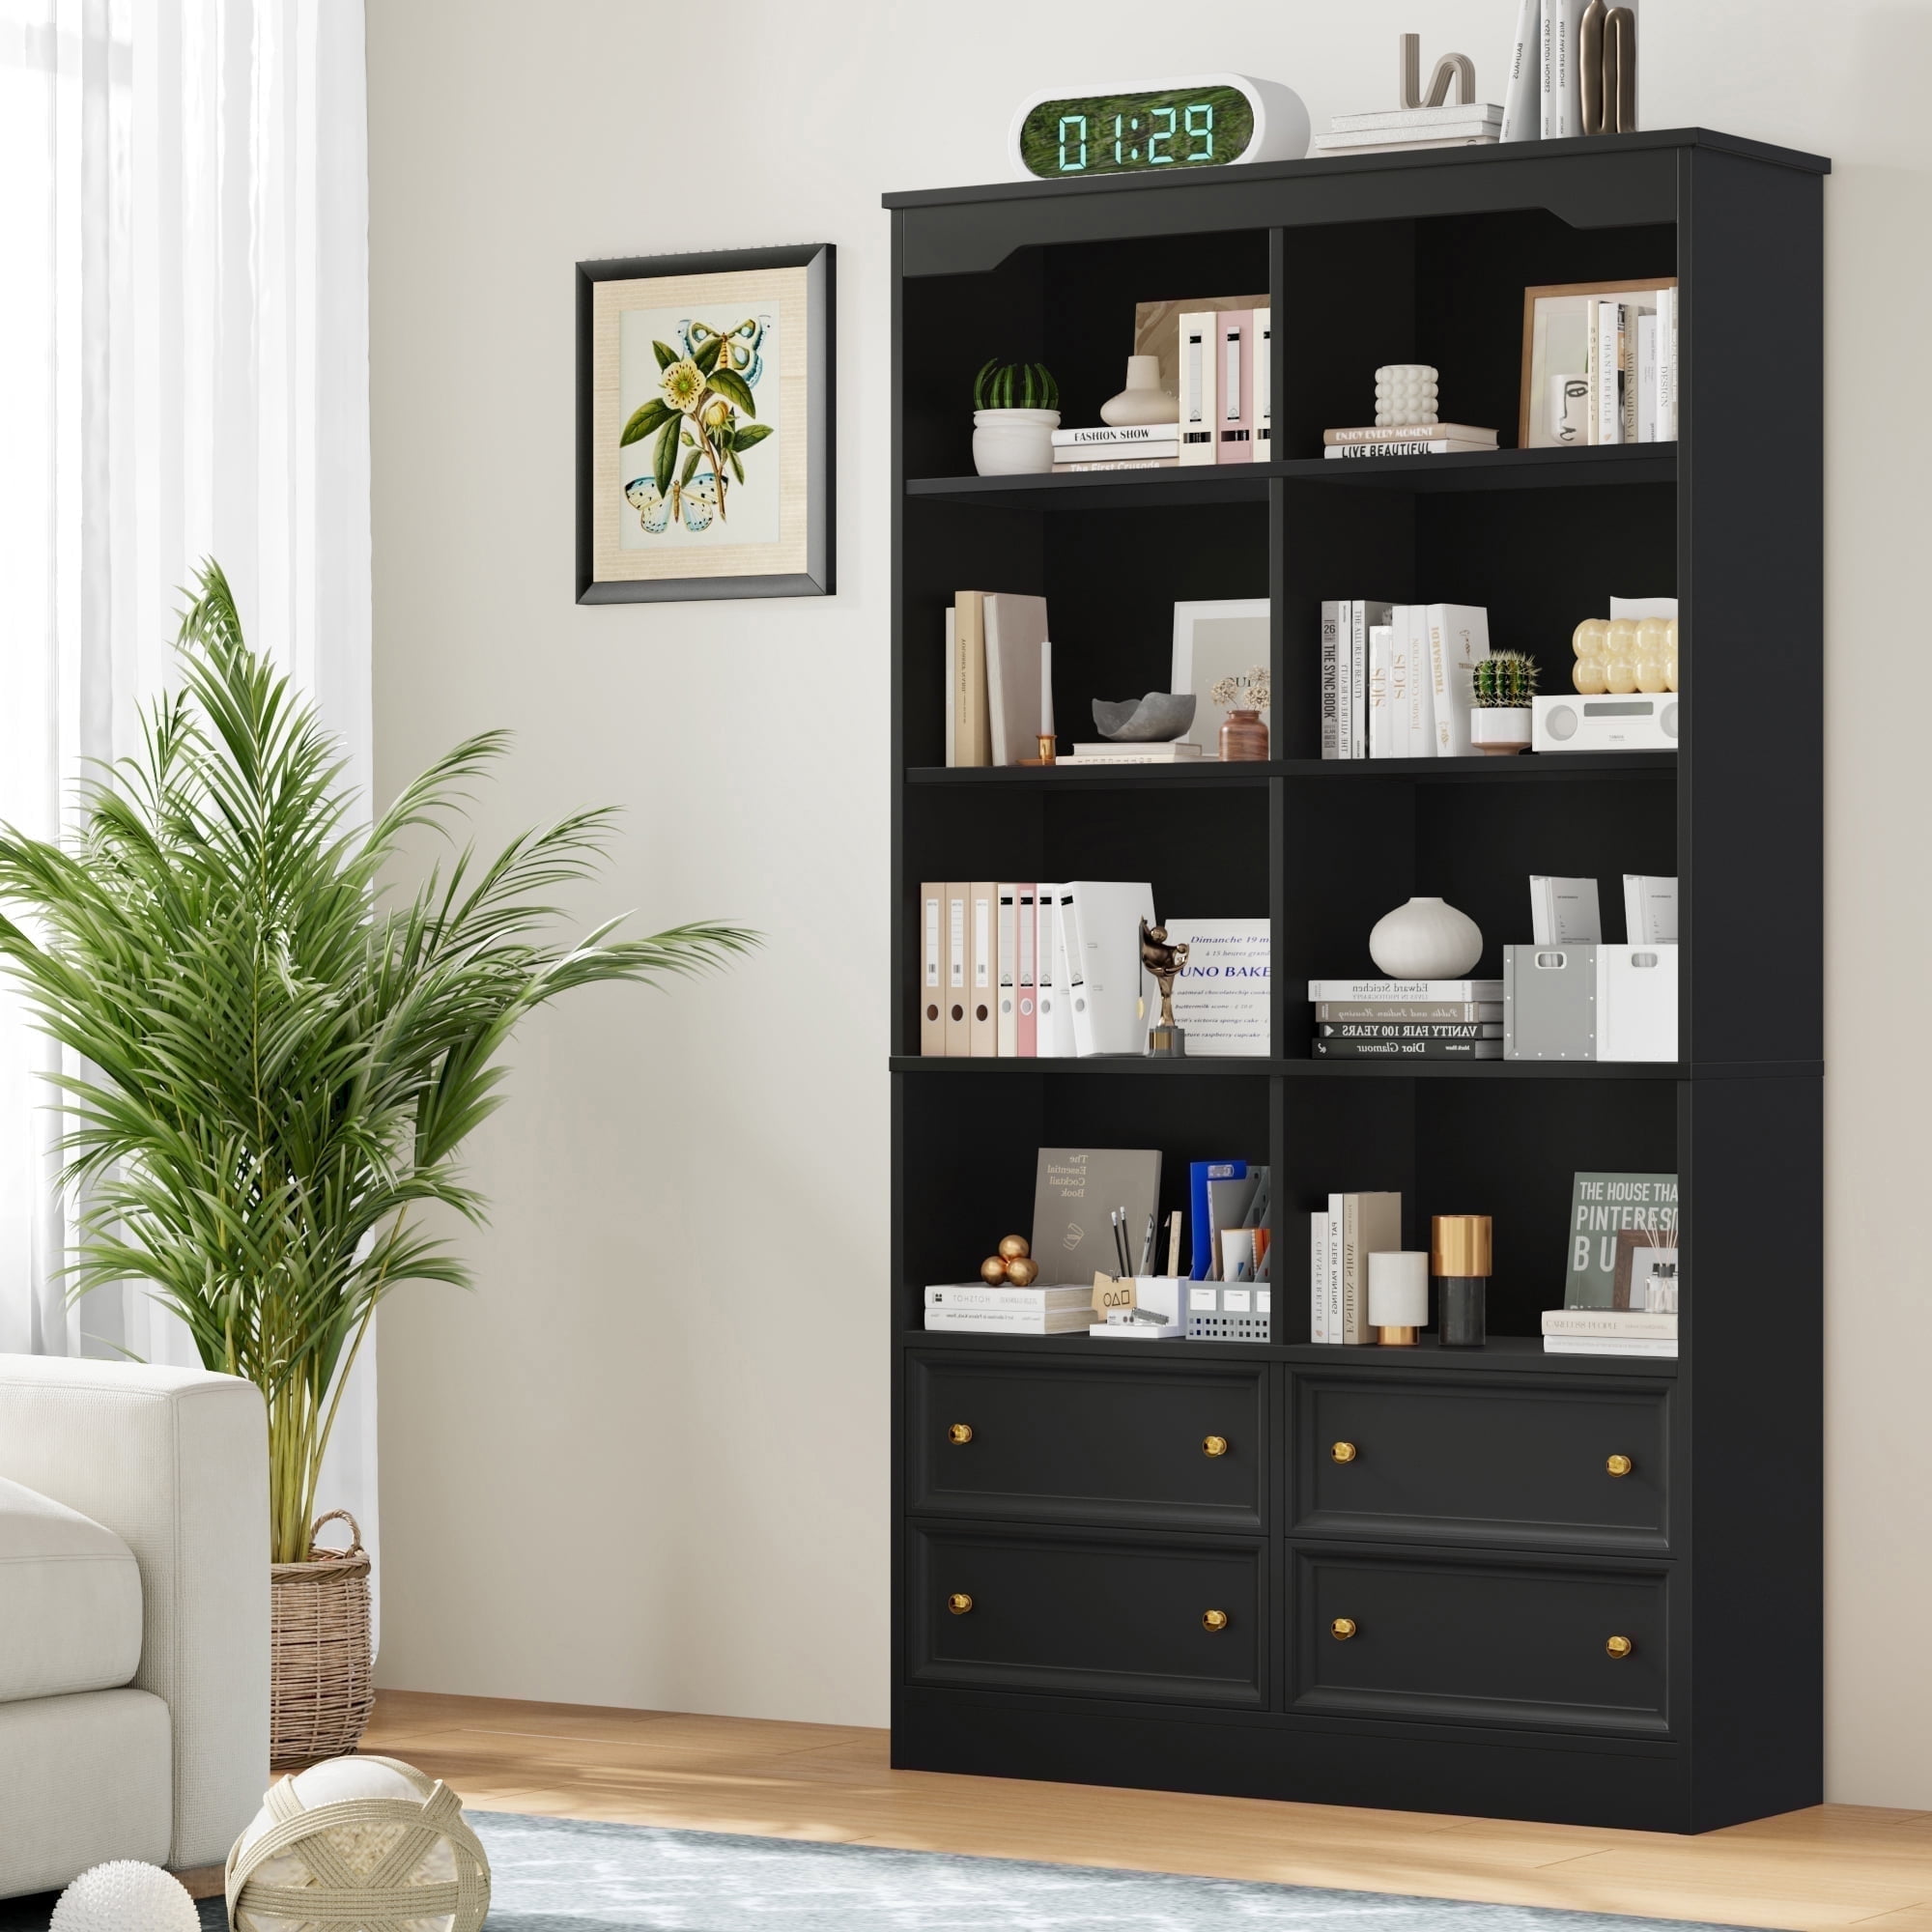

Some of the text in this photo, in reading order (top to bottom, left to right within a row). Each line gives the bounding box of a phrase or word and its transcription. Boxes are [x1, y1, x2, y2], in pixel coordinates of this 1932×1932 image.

[1059, 104, 1212, 170] 01:29
[1074, 429, 1150, 441] FASHION SHOW
[1336, 427, 1433, 440] ENJOY EVERY MOMENT
[1342, 442, 1432, 458] LIVE BEAUTIFUL
[1070, 464, 1088, 472] The
[1323, 624, 1336, 635] 26
[1323, 644, 1336, 663] THE
[1431, 626, 1443, 695] TRUSSARDI
[1323, 665, 1336, 691] SYNC
[1393, 654, 1406, 699] SICIS
[1371, 668, 1385, 707] SICIS
[1190, 935, 1242, 944] Dimanche
[1579, 1181, 1604, 1201] THE
[1607, 1182, 1650, 1202] HOUSE
